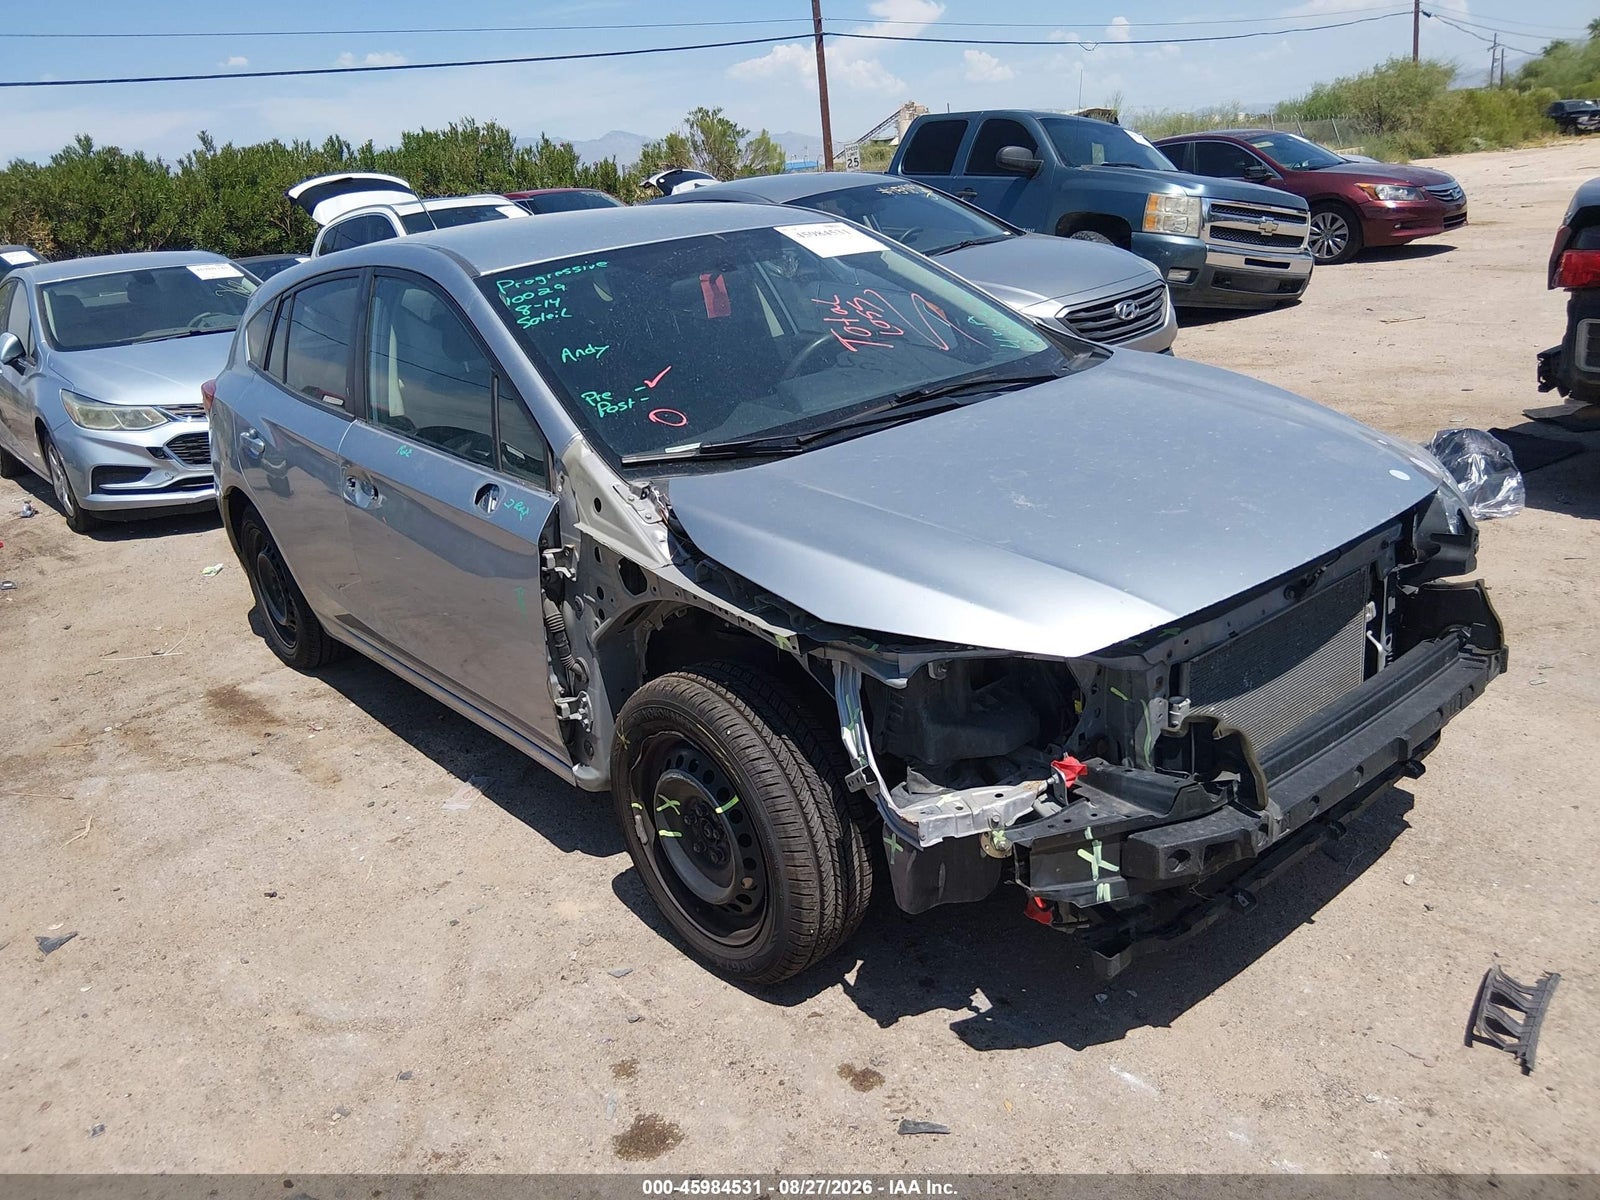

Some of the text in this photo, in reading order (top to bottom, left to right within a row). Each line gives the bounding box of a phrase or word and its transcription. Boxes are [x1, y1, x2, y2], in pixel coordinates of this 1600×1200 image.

[847, 157, 860, 169] 25
[496, 261, 609, 294] Progressive
[506, 283, 567, 306] 10029
[515, 297, 561, 316] 8-14
[561, 343, 610, 363] Andy
[581, 391, 613, 406] Pre
[597, 398, 636, 418] Post
